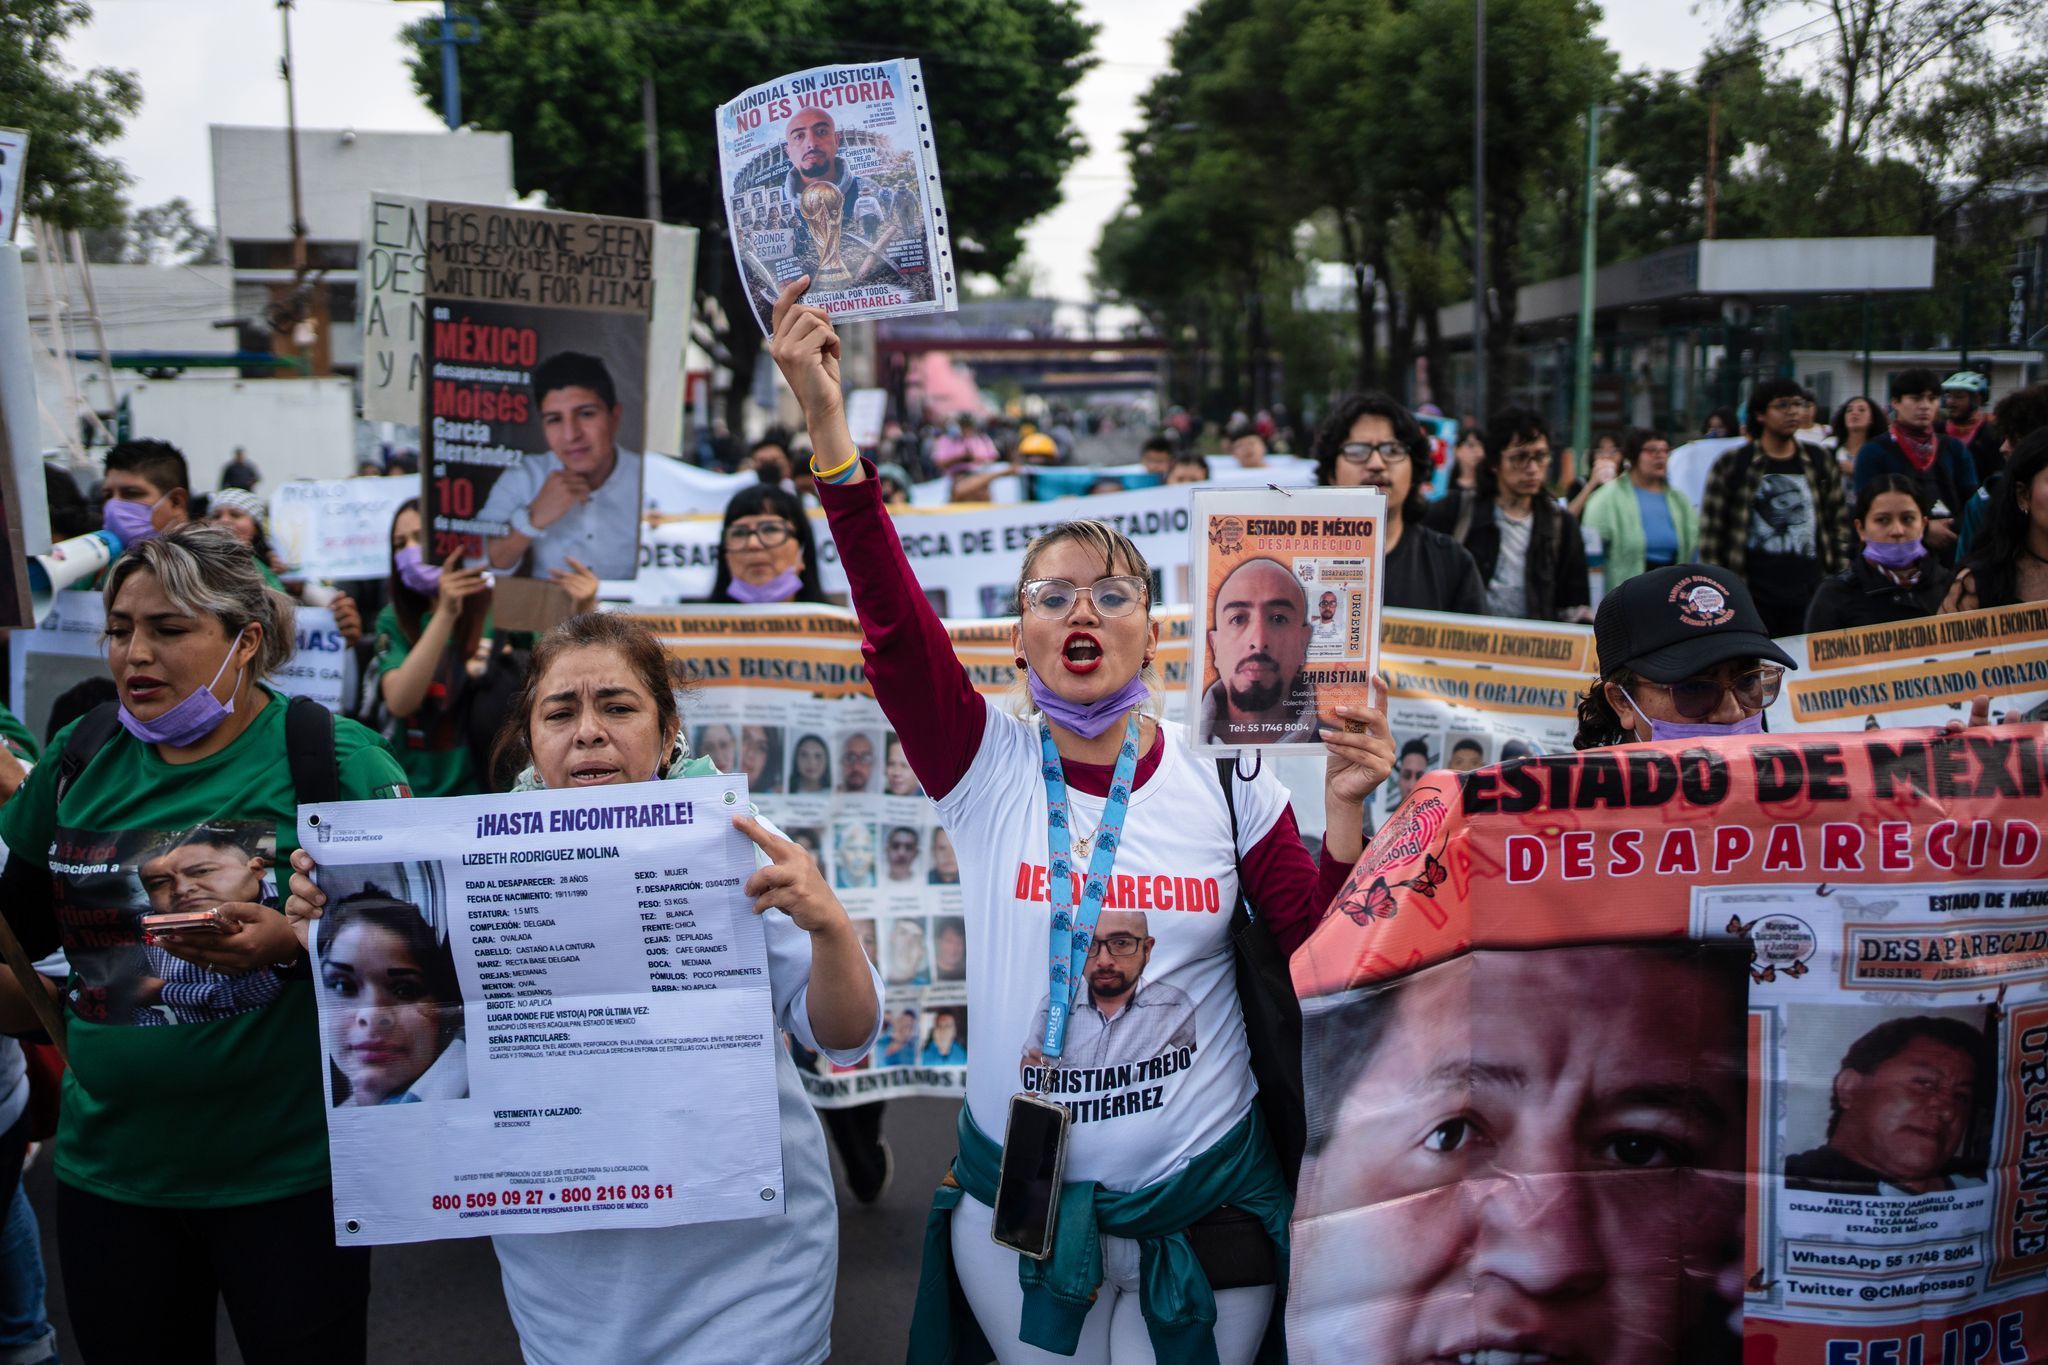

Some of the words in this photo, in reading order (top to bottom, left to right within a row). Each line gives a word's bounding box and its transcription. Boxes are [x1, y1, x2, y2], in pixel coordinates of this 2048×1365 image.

[729, 83, 788, 118] MUNDIAL
[791, 76, 816, 95] SIN
[820, 66, 891, 88] JUSTICIA,
[735, 107, 762, 134] NO
[767, 98, 793, 123] ES
[796, 80, 895, 109] VICTORIA
[845, 147, 876, 157] CHRISTIAN
[852, 155, 872, 163] TREJO
[487, 213, 575, 254] ANYONE
[584, 223, 652, 259] SEEN
[557, 253, 627, 279] FAMILY
[632, 259, 652, 281] IS
[428, 265, 531, 299] WAITING
[538, 274, 581, 303] FOR
[848, 289, 863, 299] POR
[819, 294, 901, 314] ENCONTRARLES
[433, 315, 538, 367] MÉXICO
[522, 371, 531, 385] a
[433, 380, 529, 424] Moisés
[432, 416, 491, 443] García
[432, 438, 523, 467] Hernández
[434, 476, 474, 518] 10
[1246, 519, 1297, 536] ESTADO
[1300, 519, 1318, 536] DE
[1322, 517, 1373, 537] MÉXICO
[960, 528, 994, 552] DE
[1258, 537, 1362, 551] DESAPARECIDO
[1321, 569, 1364, 577] DESAPARECIDO
[681, 617, 803, 634] DESAPARECIDAS
[1350, 593, 1362, 651] URGENTE
[1812, 635, 1861, 662] PERSONAS
[1863, 623, 1938, 656] DESAPARECIDAS
[1939, 617, 1988, 644] AYUDANOS
[1990, 615, 1998, 637] A
[739, 656, 866, 685] BUSCANDO
[1302, 670, 1367, 685] CHRISTIAN
[1396, 671, 1469, 699] BUSCANDO
[1475, 680, 1567, 709] CORAZONES
[1796, 681, 1889, 714] MARIPOSAS
[1891, 669, 1977, 701] BUSCANDO
[1229, 723, 1246, 732] Tel:
[1248, 723, 1260, 732] 55
[1261, 723, 1283, 732] 1746
[1284, 723, 1309, 732] 8004
[1456, 745, 1732, 817] ESTADO
[1750, 741, 1852, 803] DE
[476, 811, 544, 839] ¡HASTA
[550, 801, 694, 832] ENCONTRARLE!
[462, 851, 507, 866] LIZBETH
[510, 848, 575, 863] RODRIGUEZ
[576, 846, 620, 861] MOLINA
[1505, 818, 2043, 885] DESAPARECID
[465, 881, 485, 889] EDAD
[487, 880, 497, 888] AL
[498, 877, 555, 888] DESAPARECER:
[569, 875, 589, 883] AÑOS
[634, 871, 658, 880] SEXO:
[664, 868, 688, 876] MUJER
[636, 886, 644, 894] F.
[645, 881, 703, 893] DESAPARICIÓN:
[705, 878, 740, 888] 03/04/2019
[467, 895, 491, 903] FECHA
[493, 894, 503, 902] DE
[505, 891, 553, 902] NACIMIENTO:
[555, 890, 588, 899] 19/11/1990
[1929, 893, 1980, 912] ESTADO
[1984, 892, 2006, 908] DE
[1859, 929, 2048, 962] DESAPARECID
[1859, 967, 1922, 979] MISSING
[487, 1013, 512, 1022] LUGAR
[514, 1012, 539, 1021] DONDE
[540, 1011, 555, 1020] FUE
[556, 1009, 587, 1019] VISTO(A)
[588, 1008, 604, 1017] POR
[605, 1006, 632, 1016] ÚLTIMA
[633, 1006, 650, 1015] VEZ:
[1136, 1046, 1192, 1083] TREJO
[1053, 1085, 1164, 1125] UTIÉRREZ
[2012, 1024, 2048, 1259] URGENTE
[432, 1194, 462, 1210] 800
[466, 1191, 497, 1208] 509
[501, 1190, 521, 1205] 09
[525, 1189, 543, 1205] 27
[561, 1187, 592, 1203] 800
[597, 1185, 627, 1201] 216
[631, 1184, 650, 1200] 03
[654, 1183, 673, 1199] 61
[1828, 1198, 1862, 1208] FELIPE
[1865, 1199, 1905, 1209] CASTRO
[1907, 1195, 1955, 1209] JARAMILLO
[1866, 1208, 1878, 1217] EL
[1888, 1208, 1902, 1217] DE
[1904, 1204, 1950, 1217] DICIEMBRE
[1952, 1202, 1964, 1211] DE
[1846, 1224, 1888, 1234] ESTADO
[1890, 1224, 1902, 1233] DE
[1904, 1221, 1938, 1233] MÉXICO
[1792, 1250, 1881, 1270] WhatsApp
[1885, 1255, 1903, 1268] 55
[1907, 1250, 1939, 1264] 1746
[1943, 1245, 1974, 1261] 8004
[1786, 1279, 1854, 1297] Twitter
[1859, 1275, 1975, 1301] @CMariposasD
